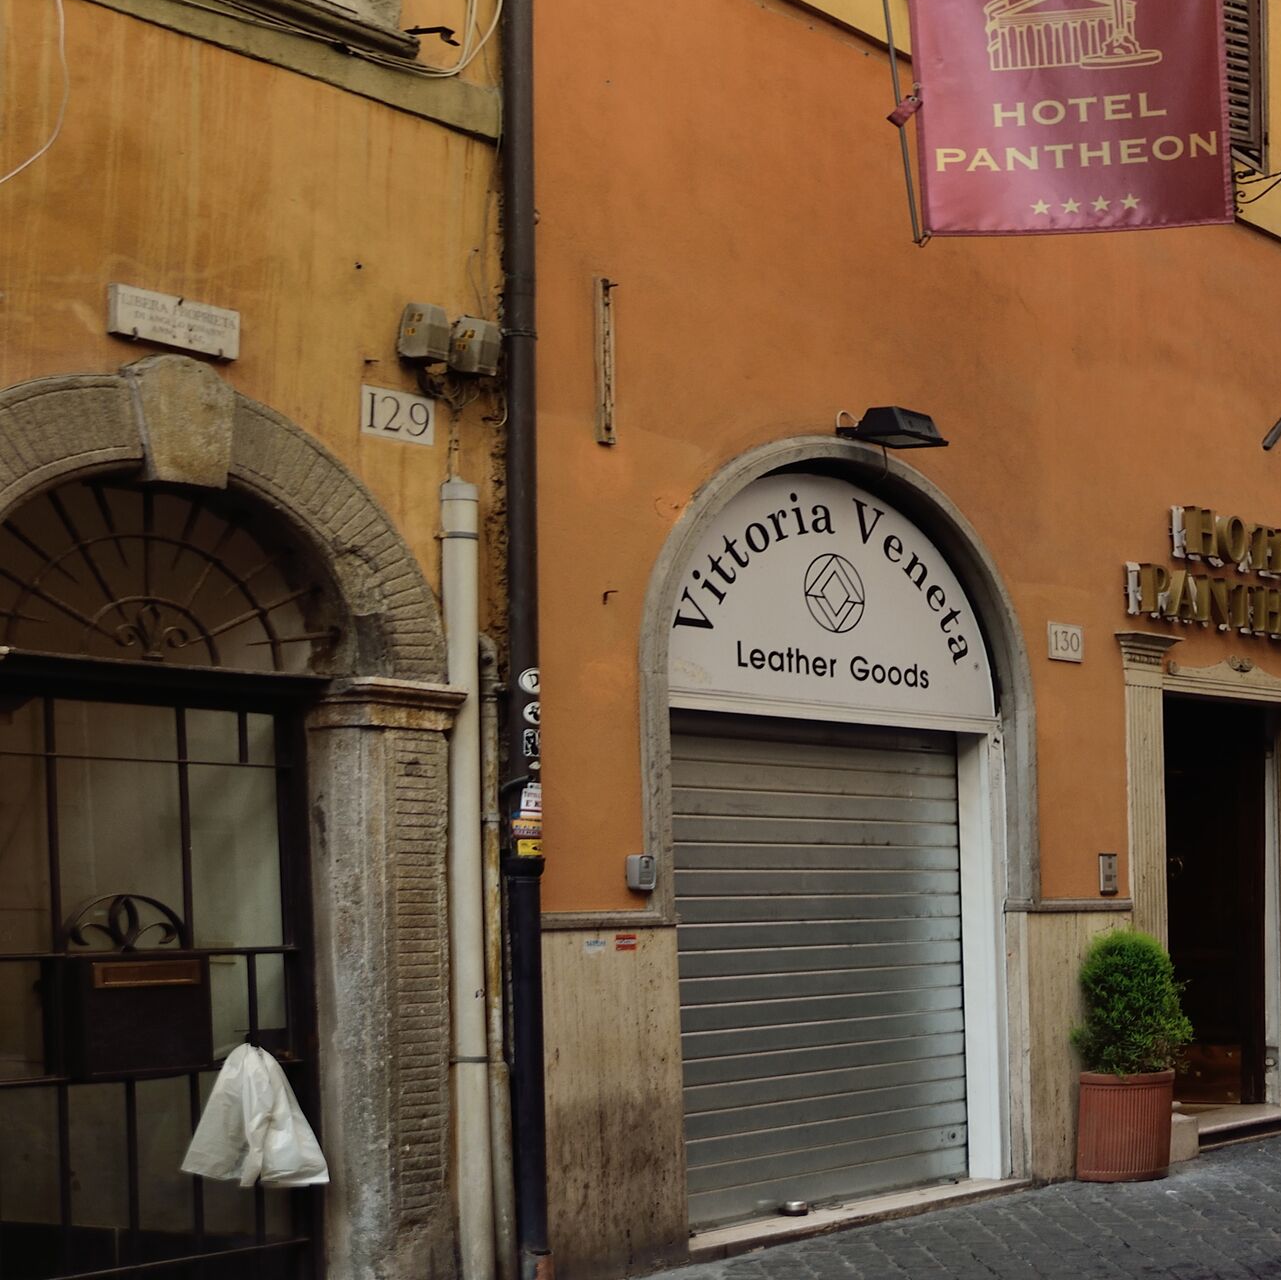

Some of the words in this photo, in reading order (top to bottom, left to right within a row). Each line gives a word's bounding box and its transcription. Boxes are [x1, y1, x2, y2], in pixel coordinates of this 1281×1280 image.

[993, 92, 1167, 128] HOTEL
[936, 130, 1218, 172] PANTHEON
[367, 392, 430, 437] 129
[672, 492, 836, 630] Vittoria
[852, 497, 969, 665] Veneta
[1054, 630, 1080, 652] 130
[736, 640, 837, 678] Leather
[850, 655, 930, 689] Goods
